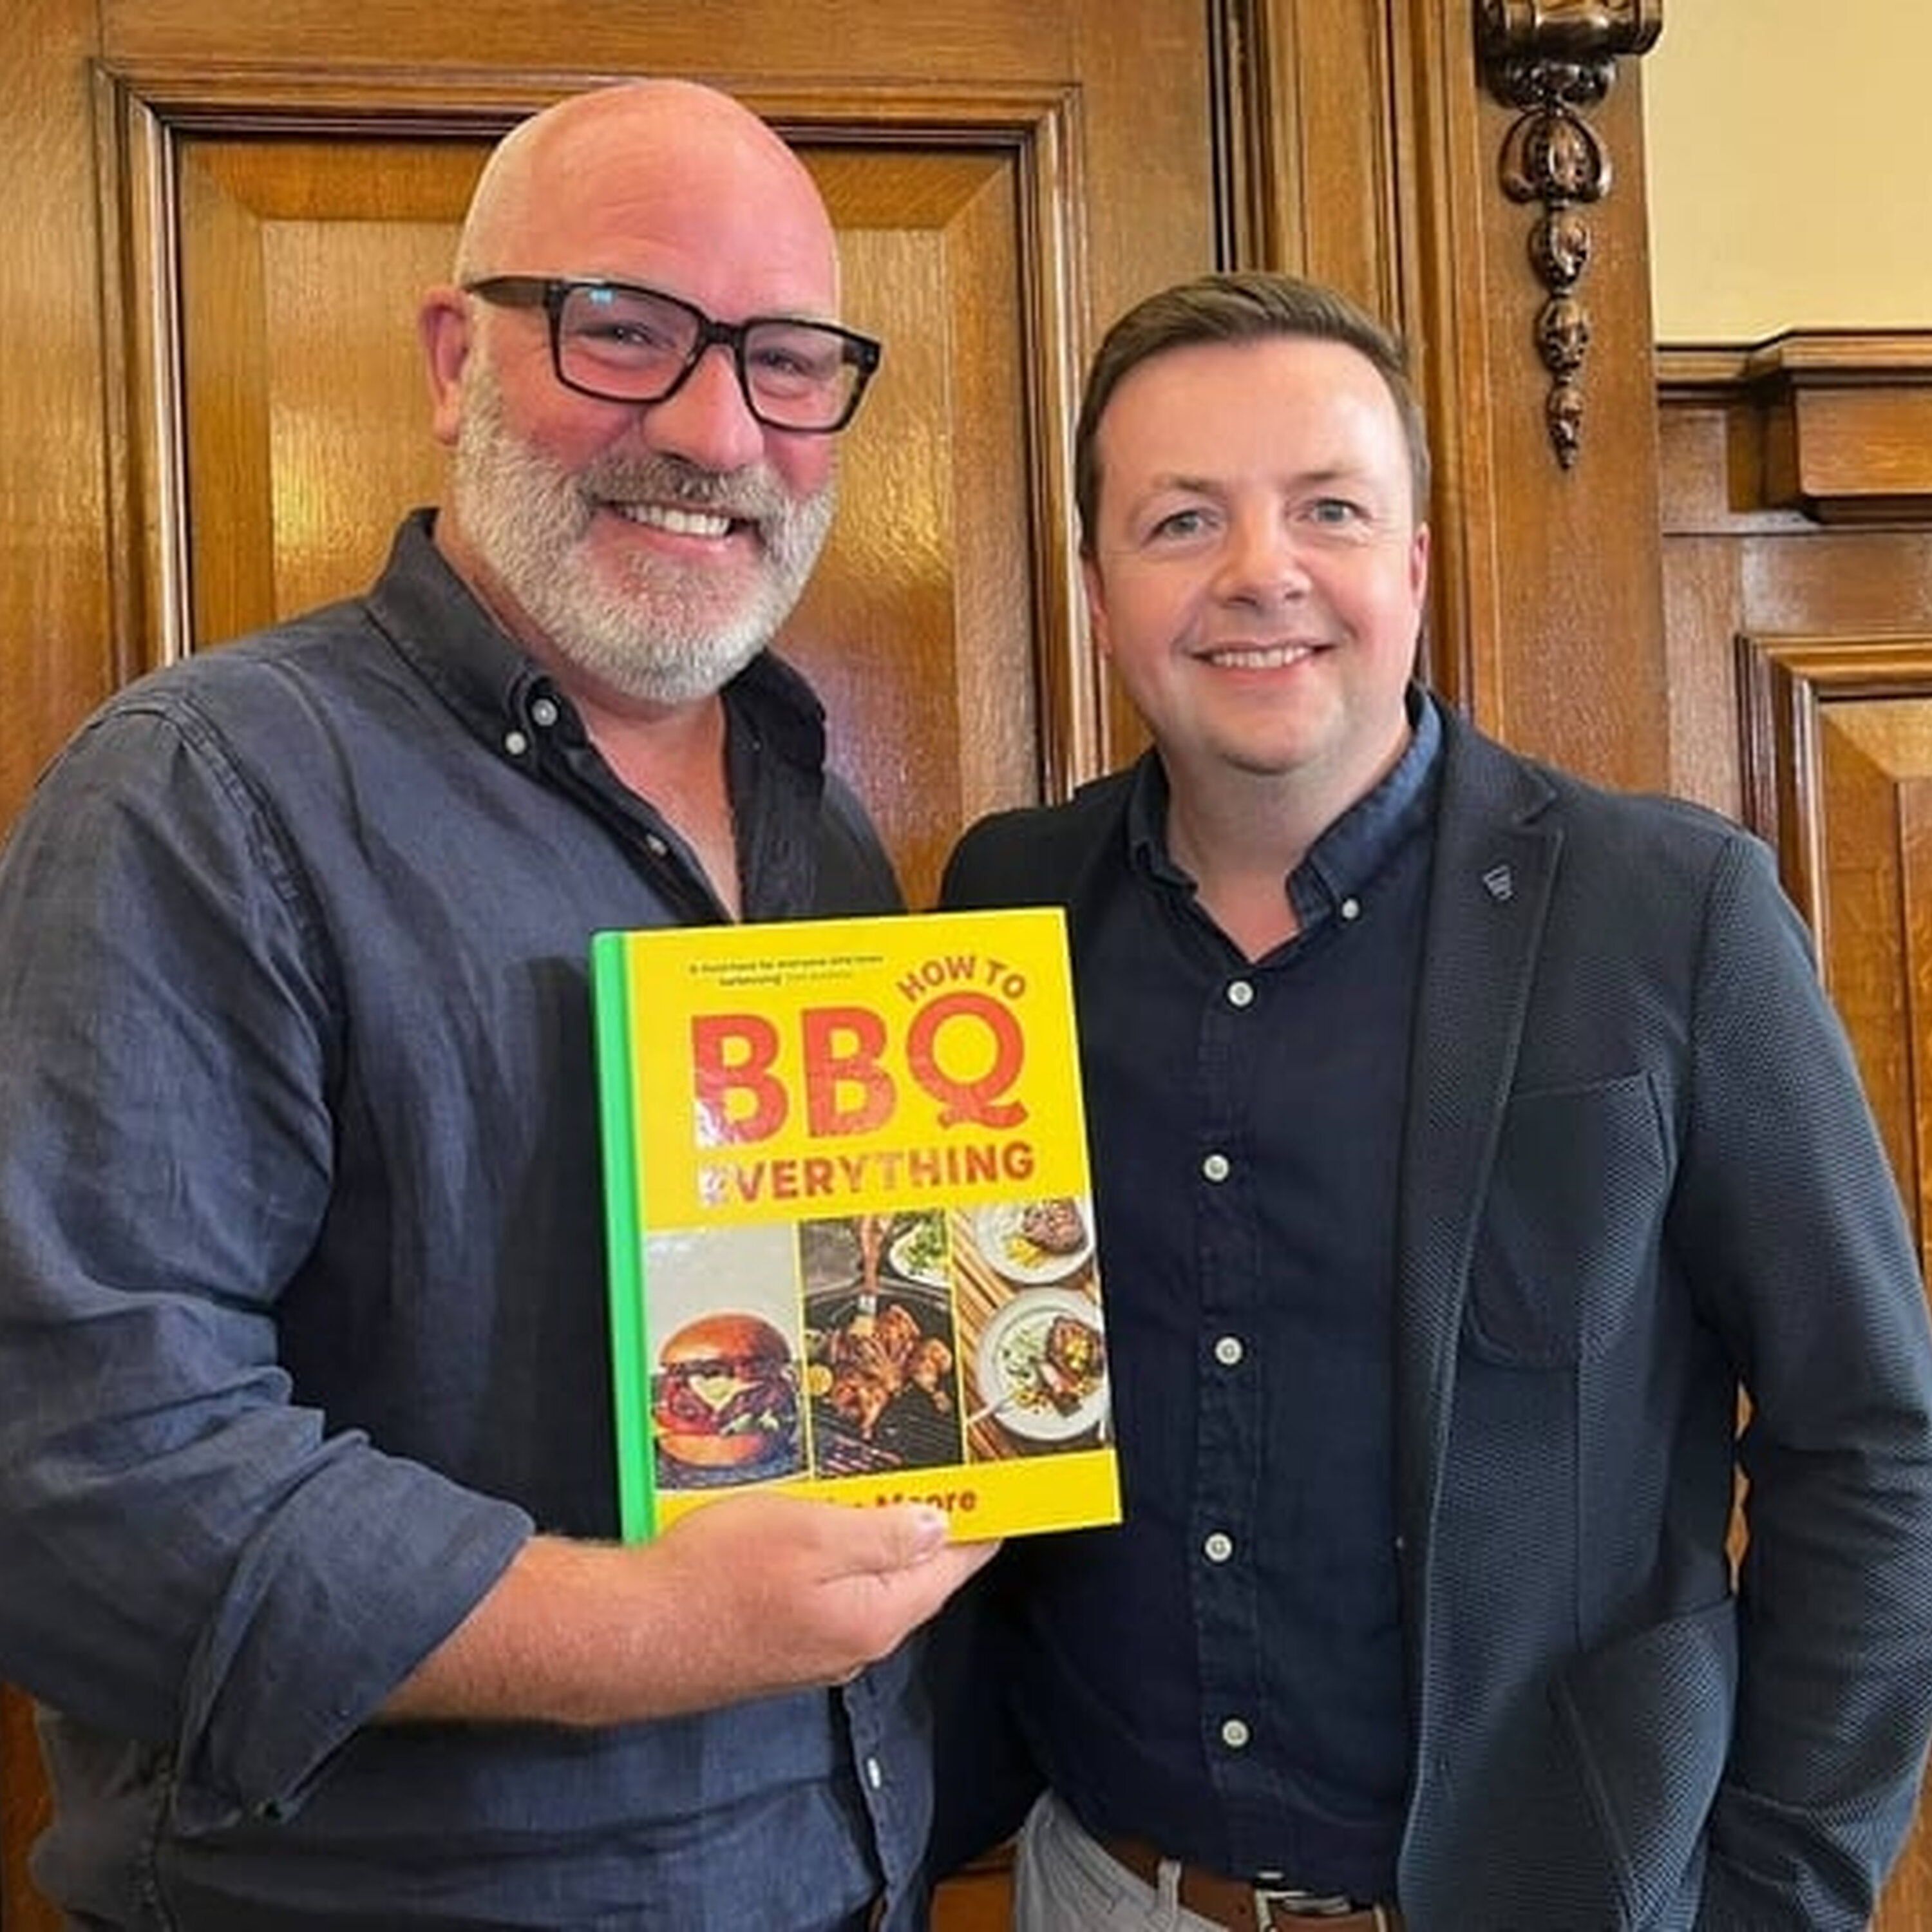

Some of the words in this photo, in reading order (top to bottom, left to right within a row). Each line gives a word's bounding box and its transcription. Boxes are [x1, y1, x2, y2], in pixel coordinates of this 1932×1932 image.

[896, 956, 976, 1002] HOW
[987, 958, 1027, 1000] TO
[691, 990, 1028, 1149] BBQ
